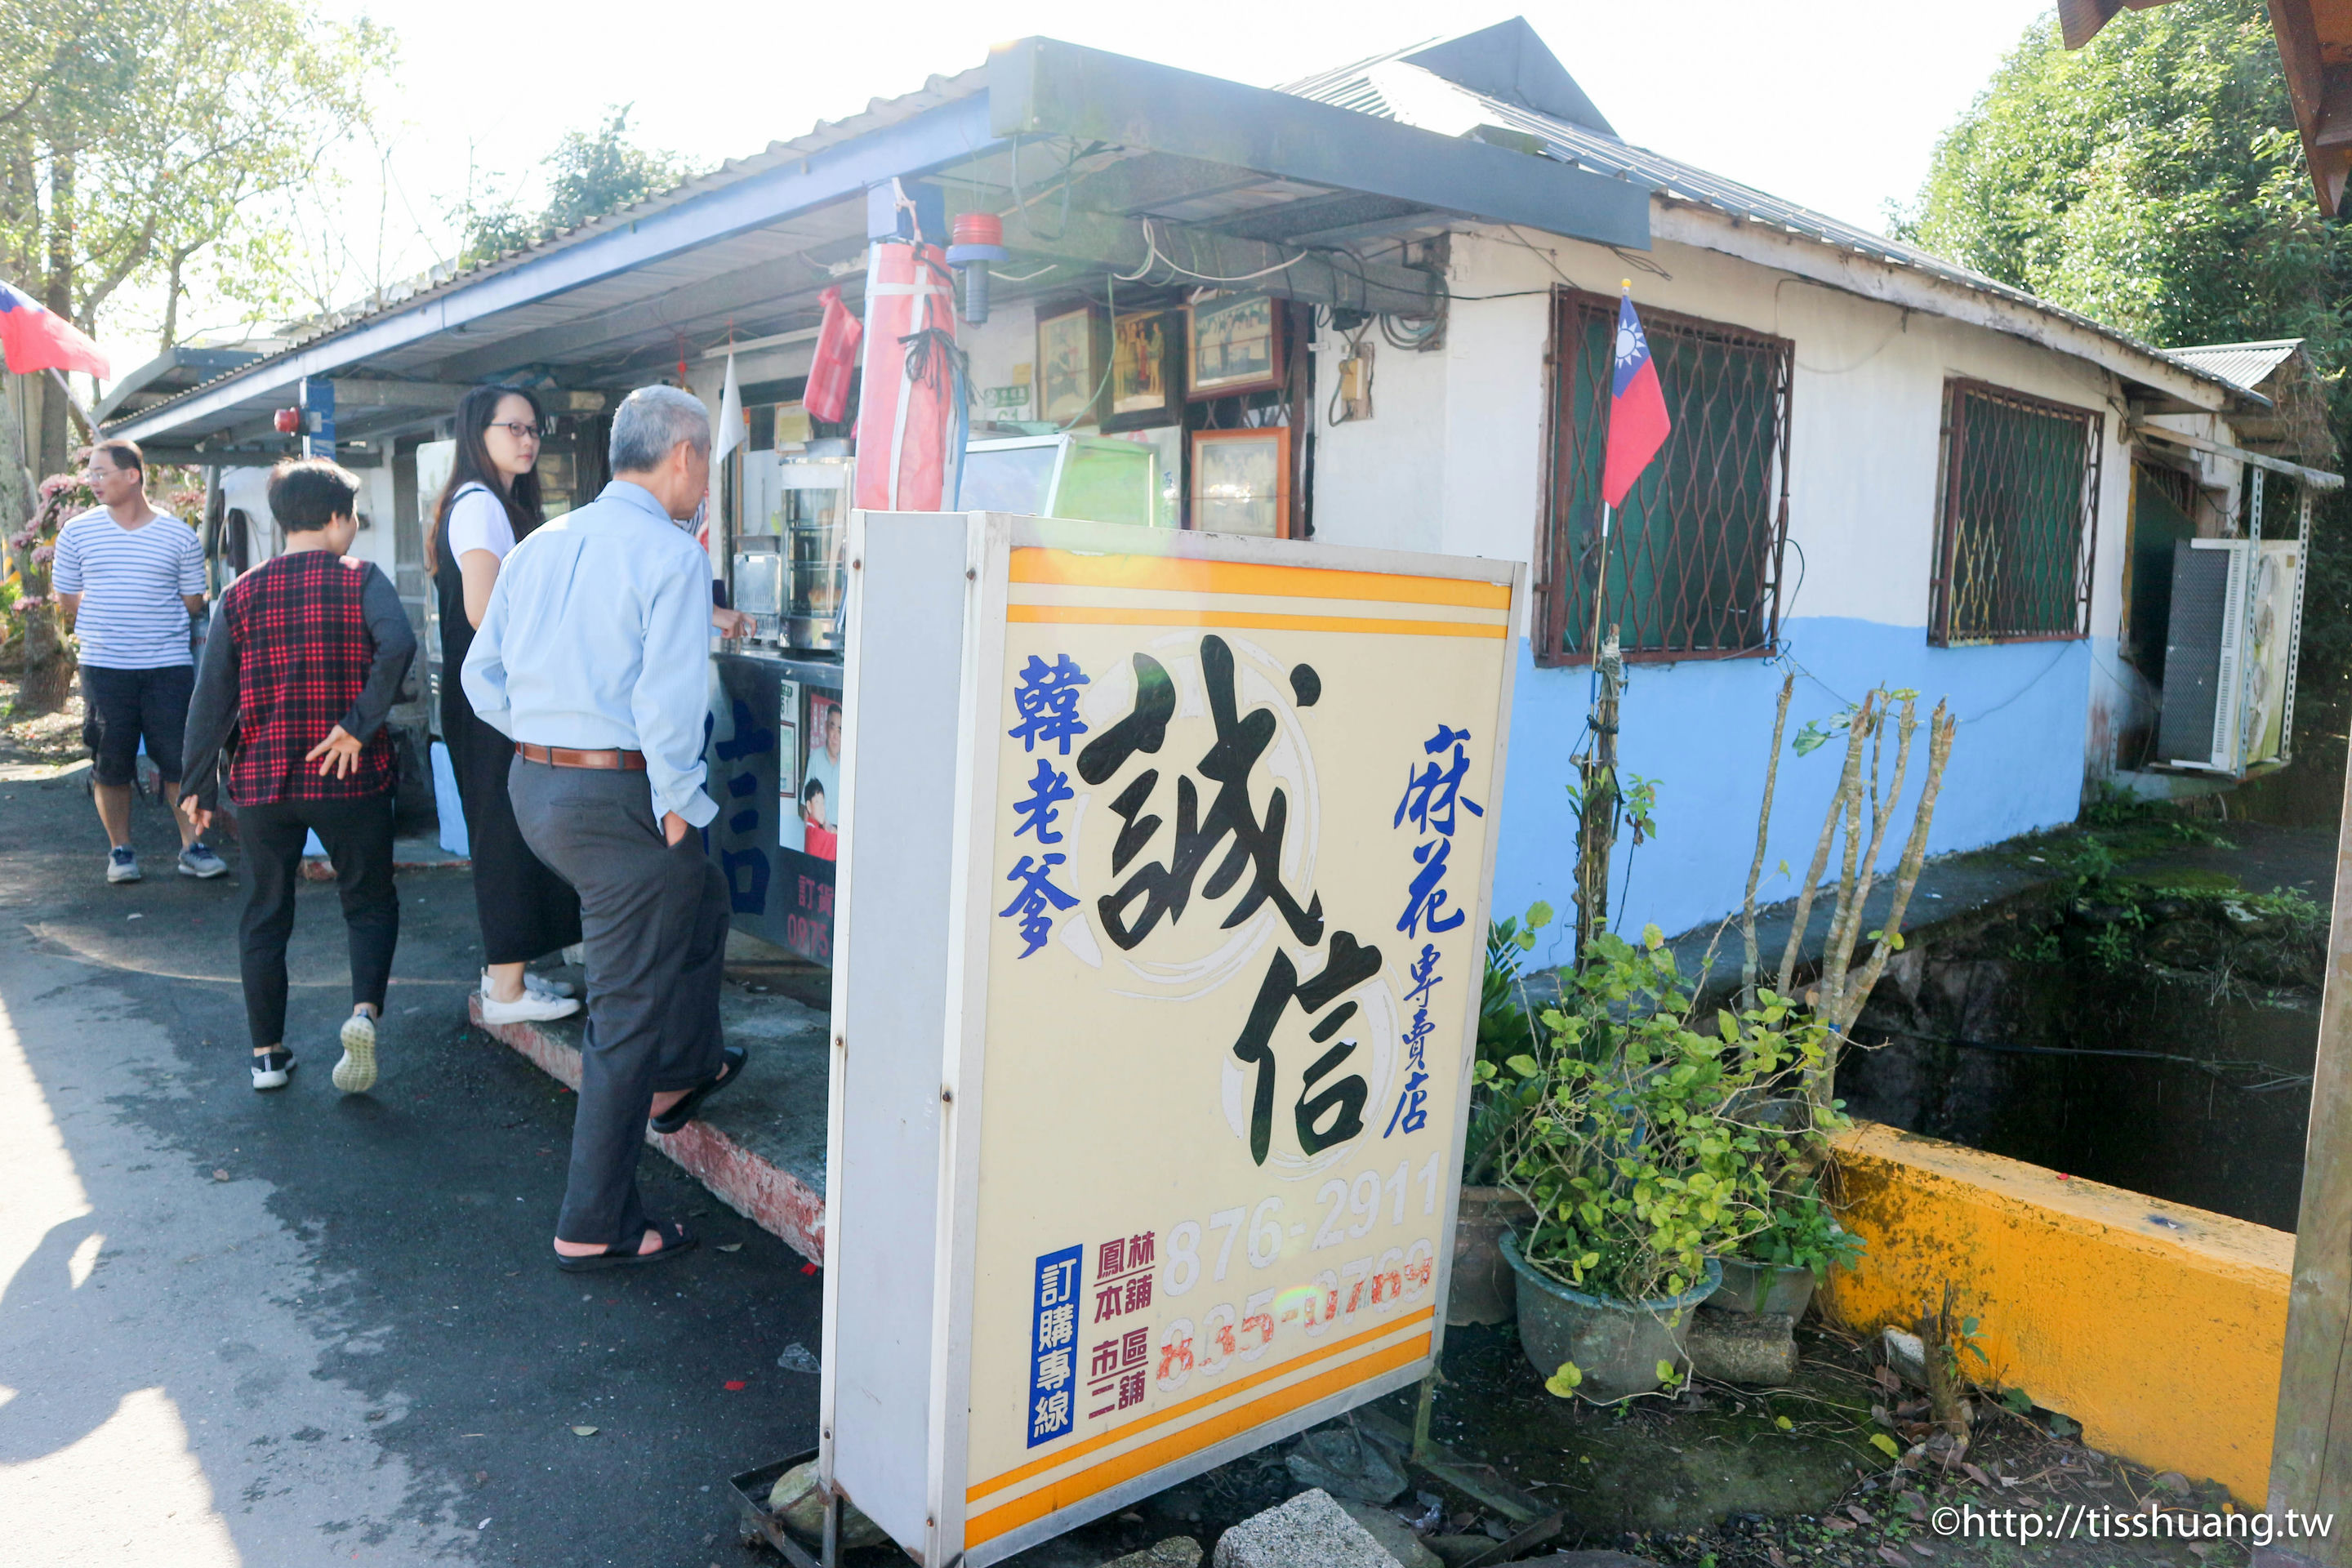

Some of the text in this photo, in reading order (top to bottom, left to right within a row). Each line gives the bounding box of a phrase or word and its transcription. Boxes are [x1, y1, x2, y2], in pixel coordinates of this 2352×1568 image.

[999, 653, 1090, 959] 韓老爹
[1077, 634, 1383, 1167] 誠信
[1097, 1231, 1156, 1280] 鳳林
[1162, 1151, 1441, 1298] 876-2911
[1034, 1258, 1077, 1438] 訂購專線
[1091, 1326, 1149, 1377] 市區
[1156, 1237, 1434, 1392] 835-0769
